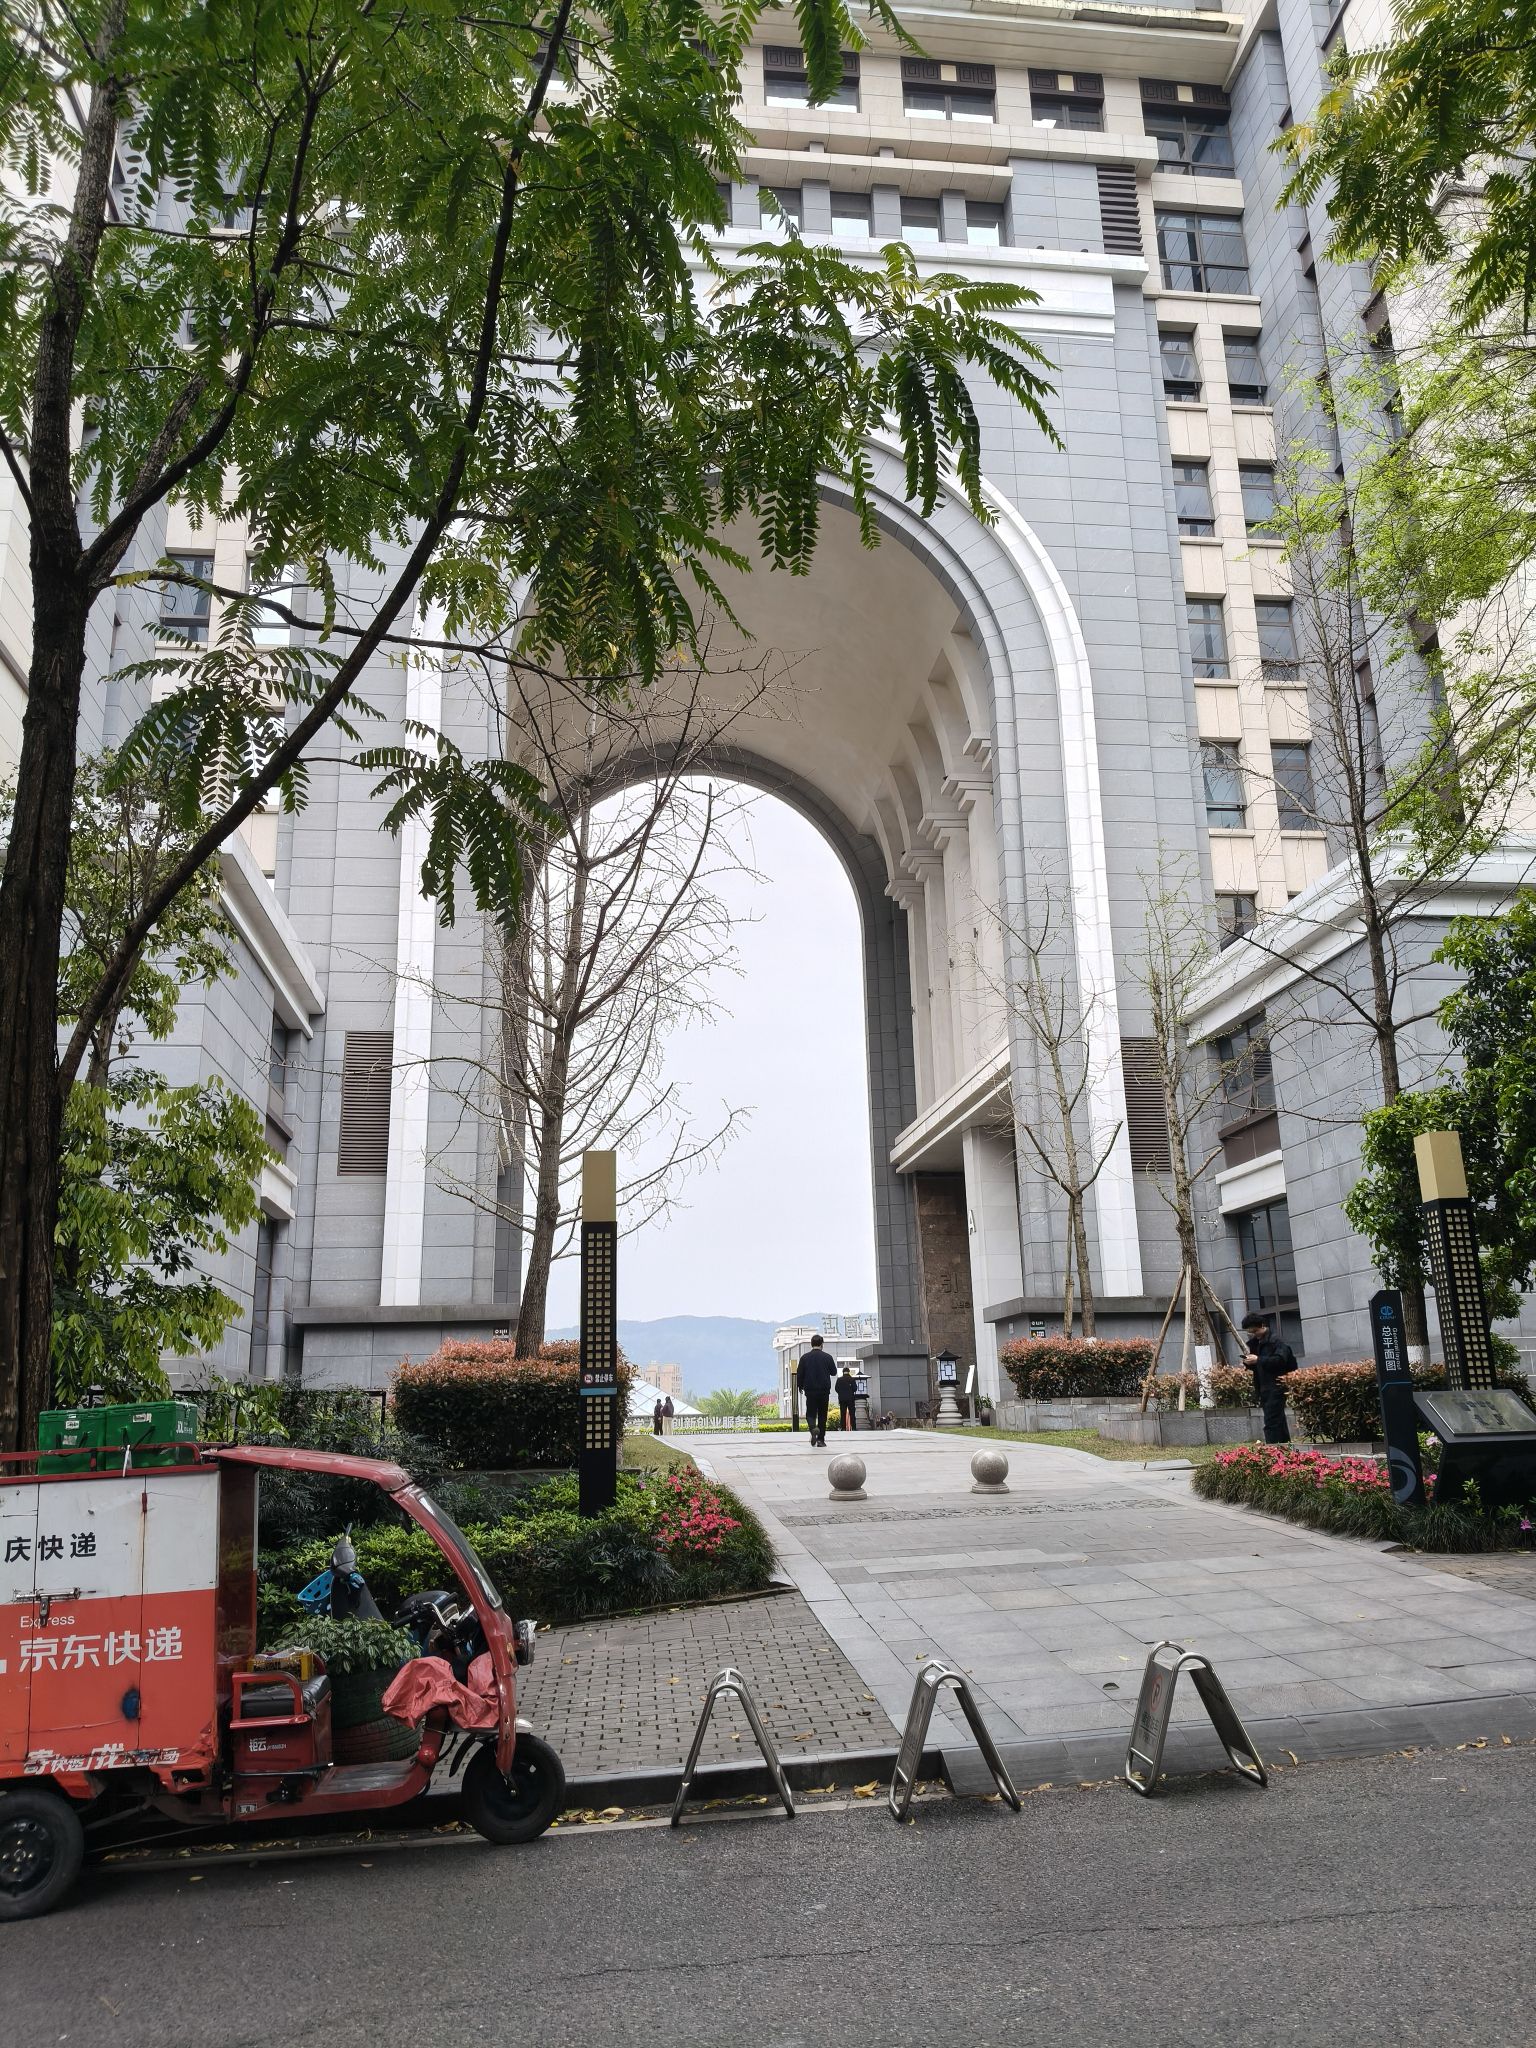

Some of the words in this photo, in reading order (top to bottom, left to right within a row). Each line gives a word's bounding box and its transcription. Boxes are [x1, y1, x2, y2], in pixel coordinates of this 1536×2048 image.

[1382, 1326, 1397, 1371] 总平面图
[4, 1531, 97, 1563] 庆快递
[19, 1626, 183, 1673] 京东快递
